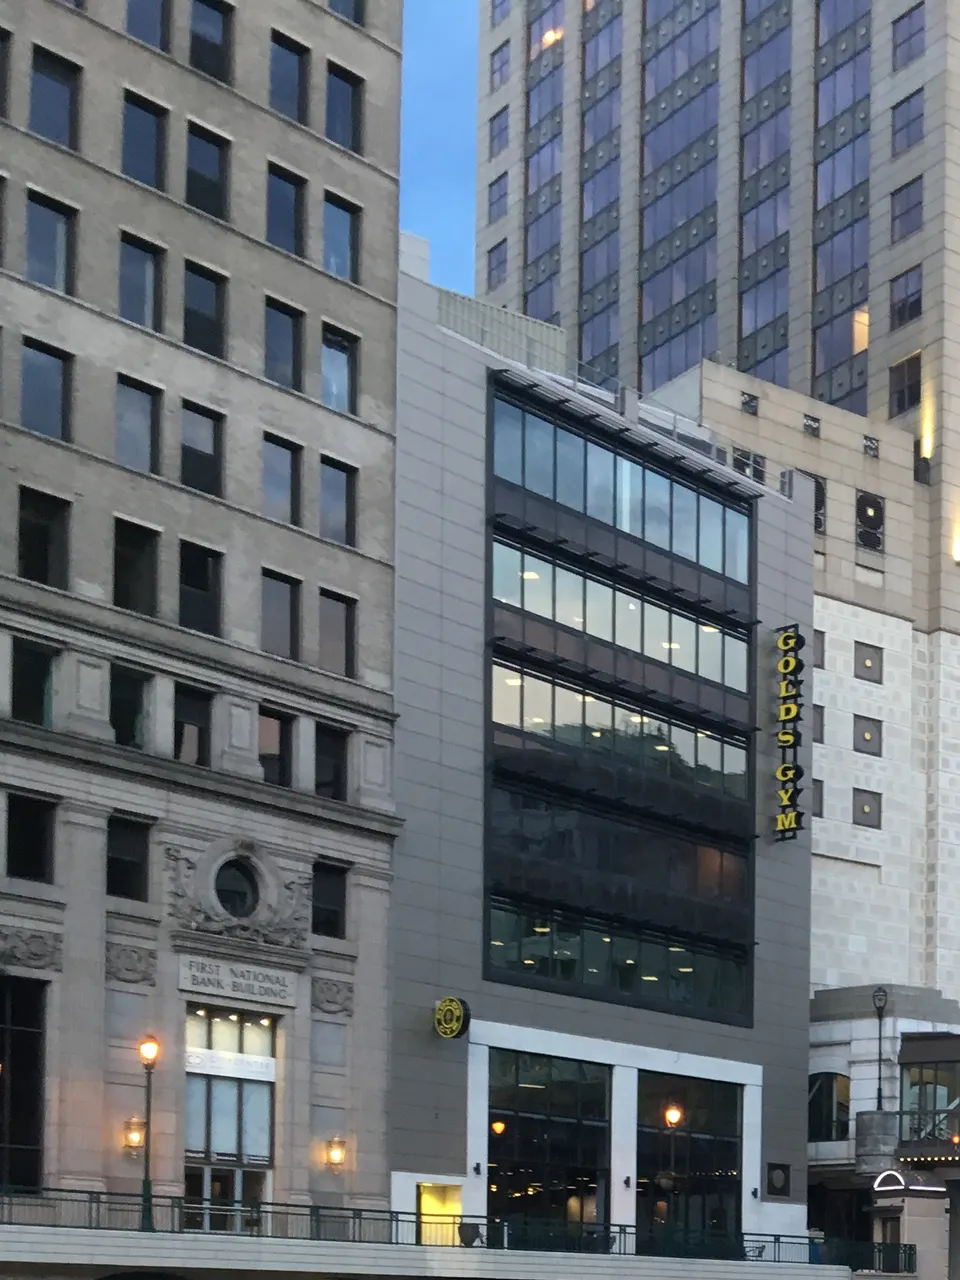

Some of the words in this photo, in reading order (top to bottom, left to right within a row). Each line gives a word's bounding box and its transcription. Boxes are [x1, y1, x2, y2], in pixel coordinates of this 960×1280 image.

[775, 763, 798, 831] GYM
[187, 960, 222, 976] FIRST
[229, 967, 289, 988] NATIONAL
[191, 974, 224, 990] BANK
[231, 981, 288, 1000] BUILDING
